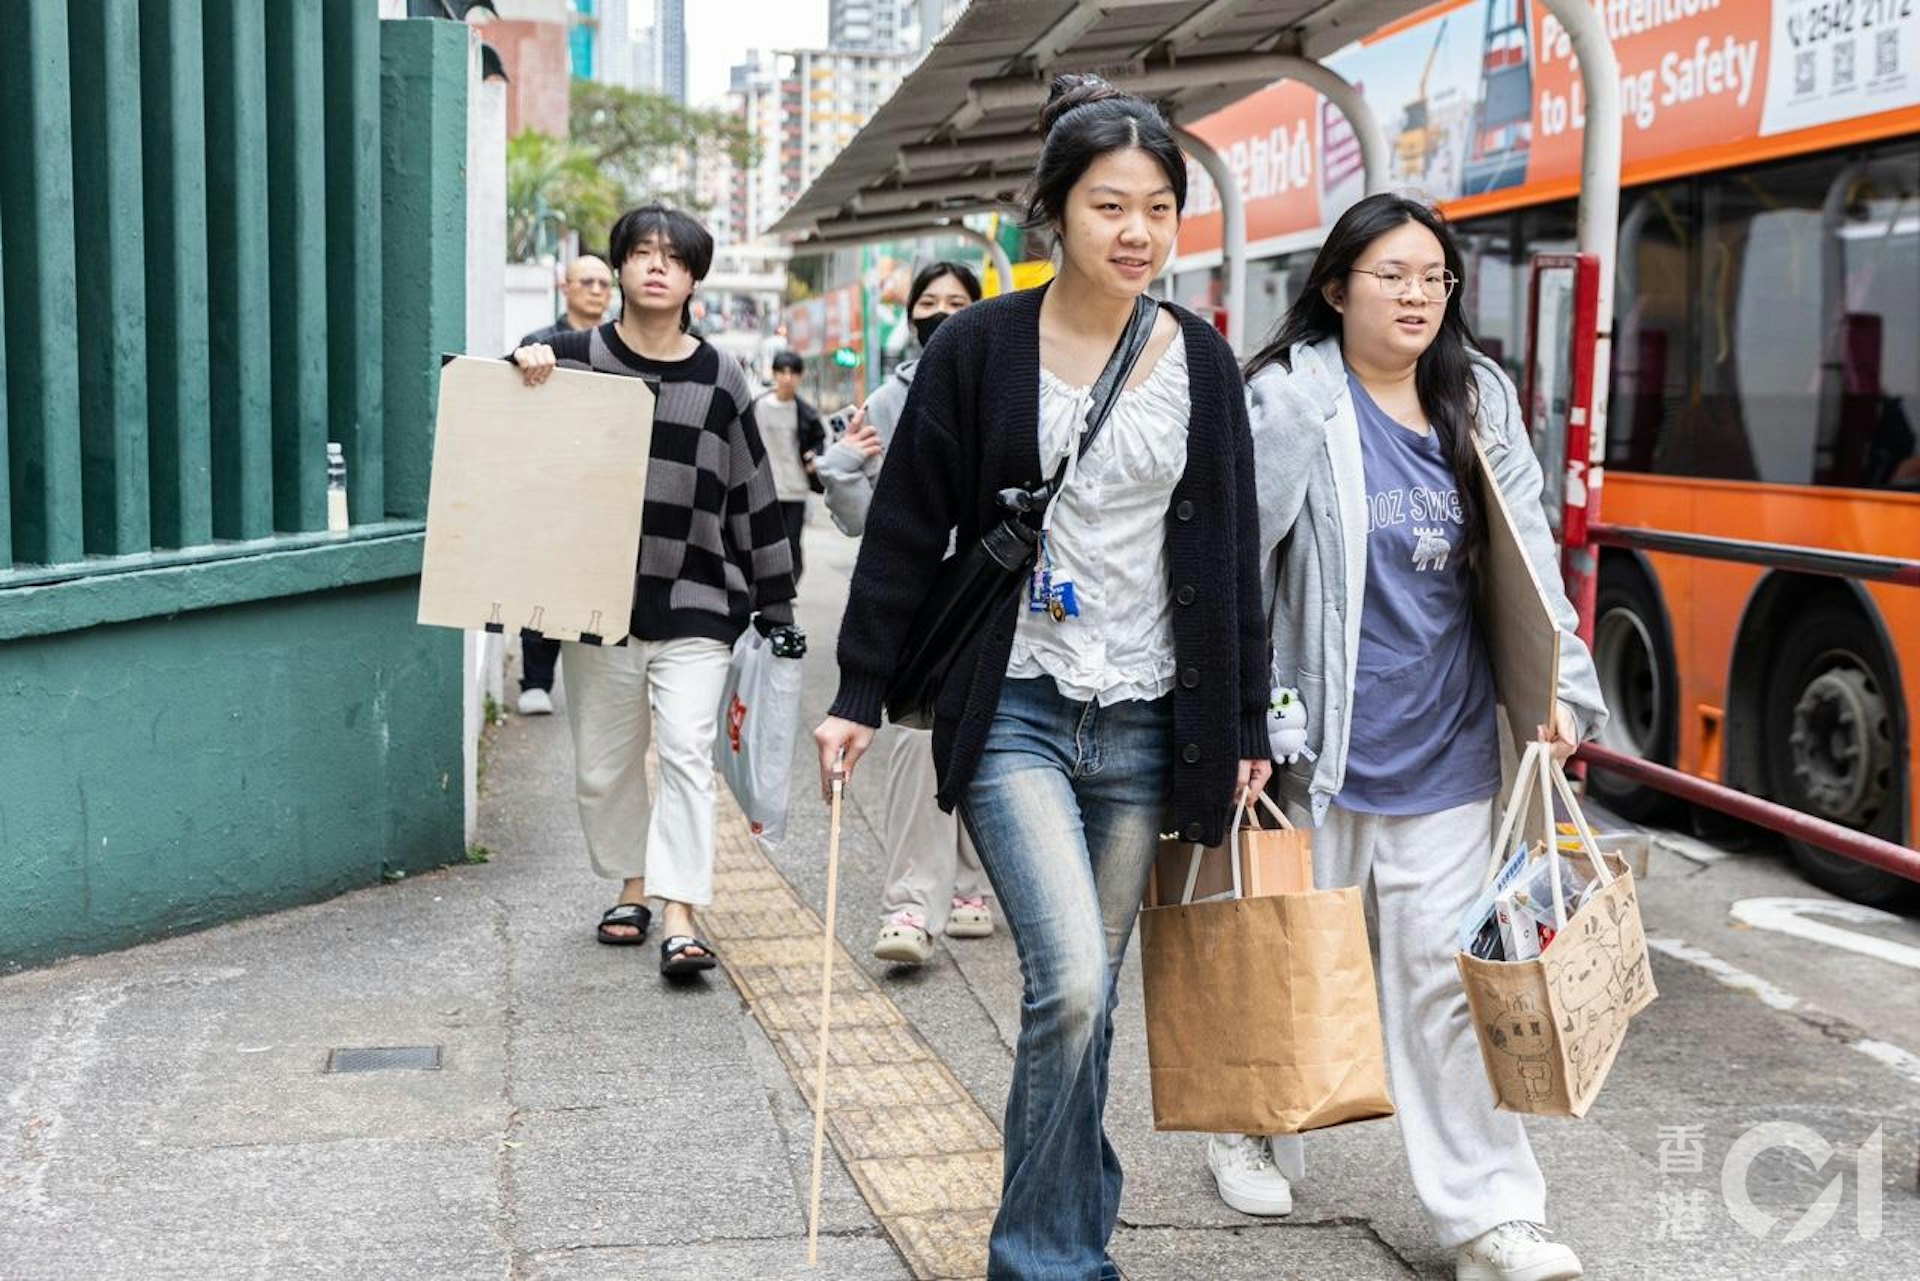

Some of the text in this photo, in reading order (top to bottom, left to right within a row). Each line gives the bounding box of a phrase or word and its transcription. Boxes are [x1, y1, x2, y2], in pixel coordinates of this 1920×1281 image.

[1541, 13, 1580, 72] Pa
[1540, 90, 1567, 136] to
[1660, 35, 1759, 107] Safety
